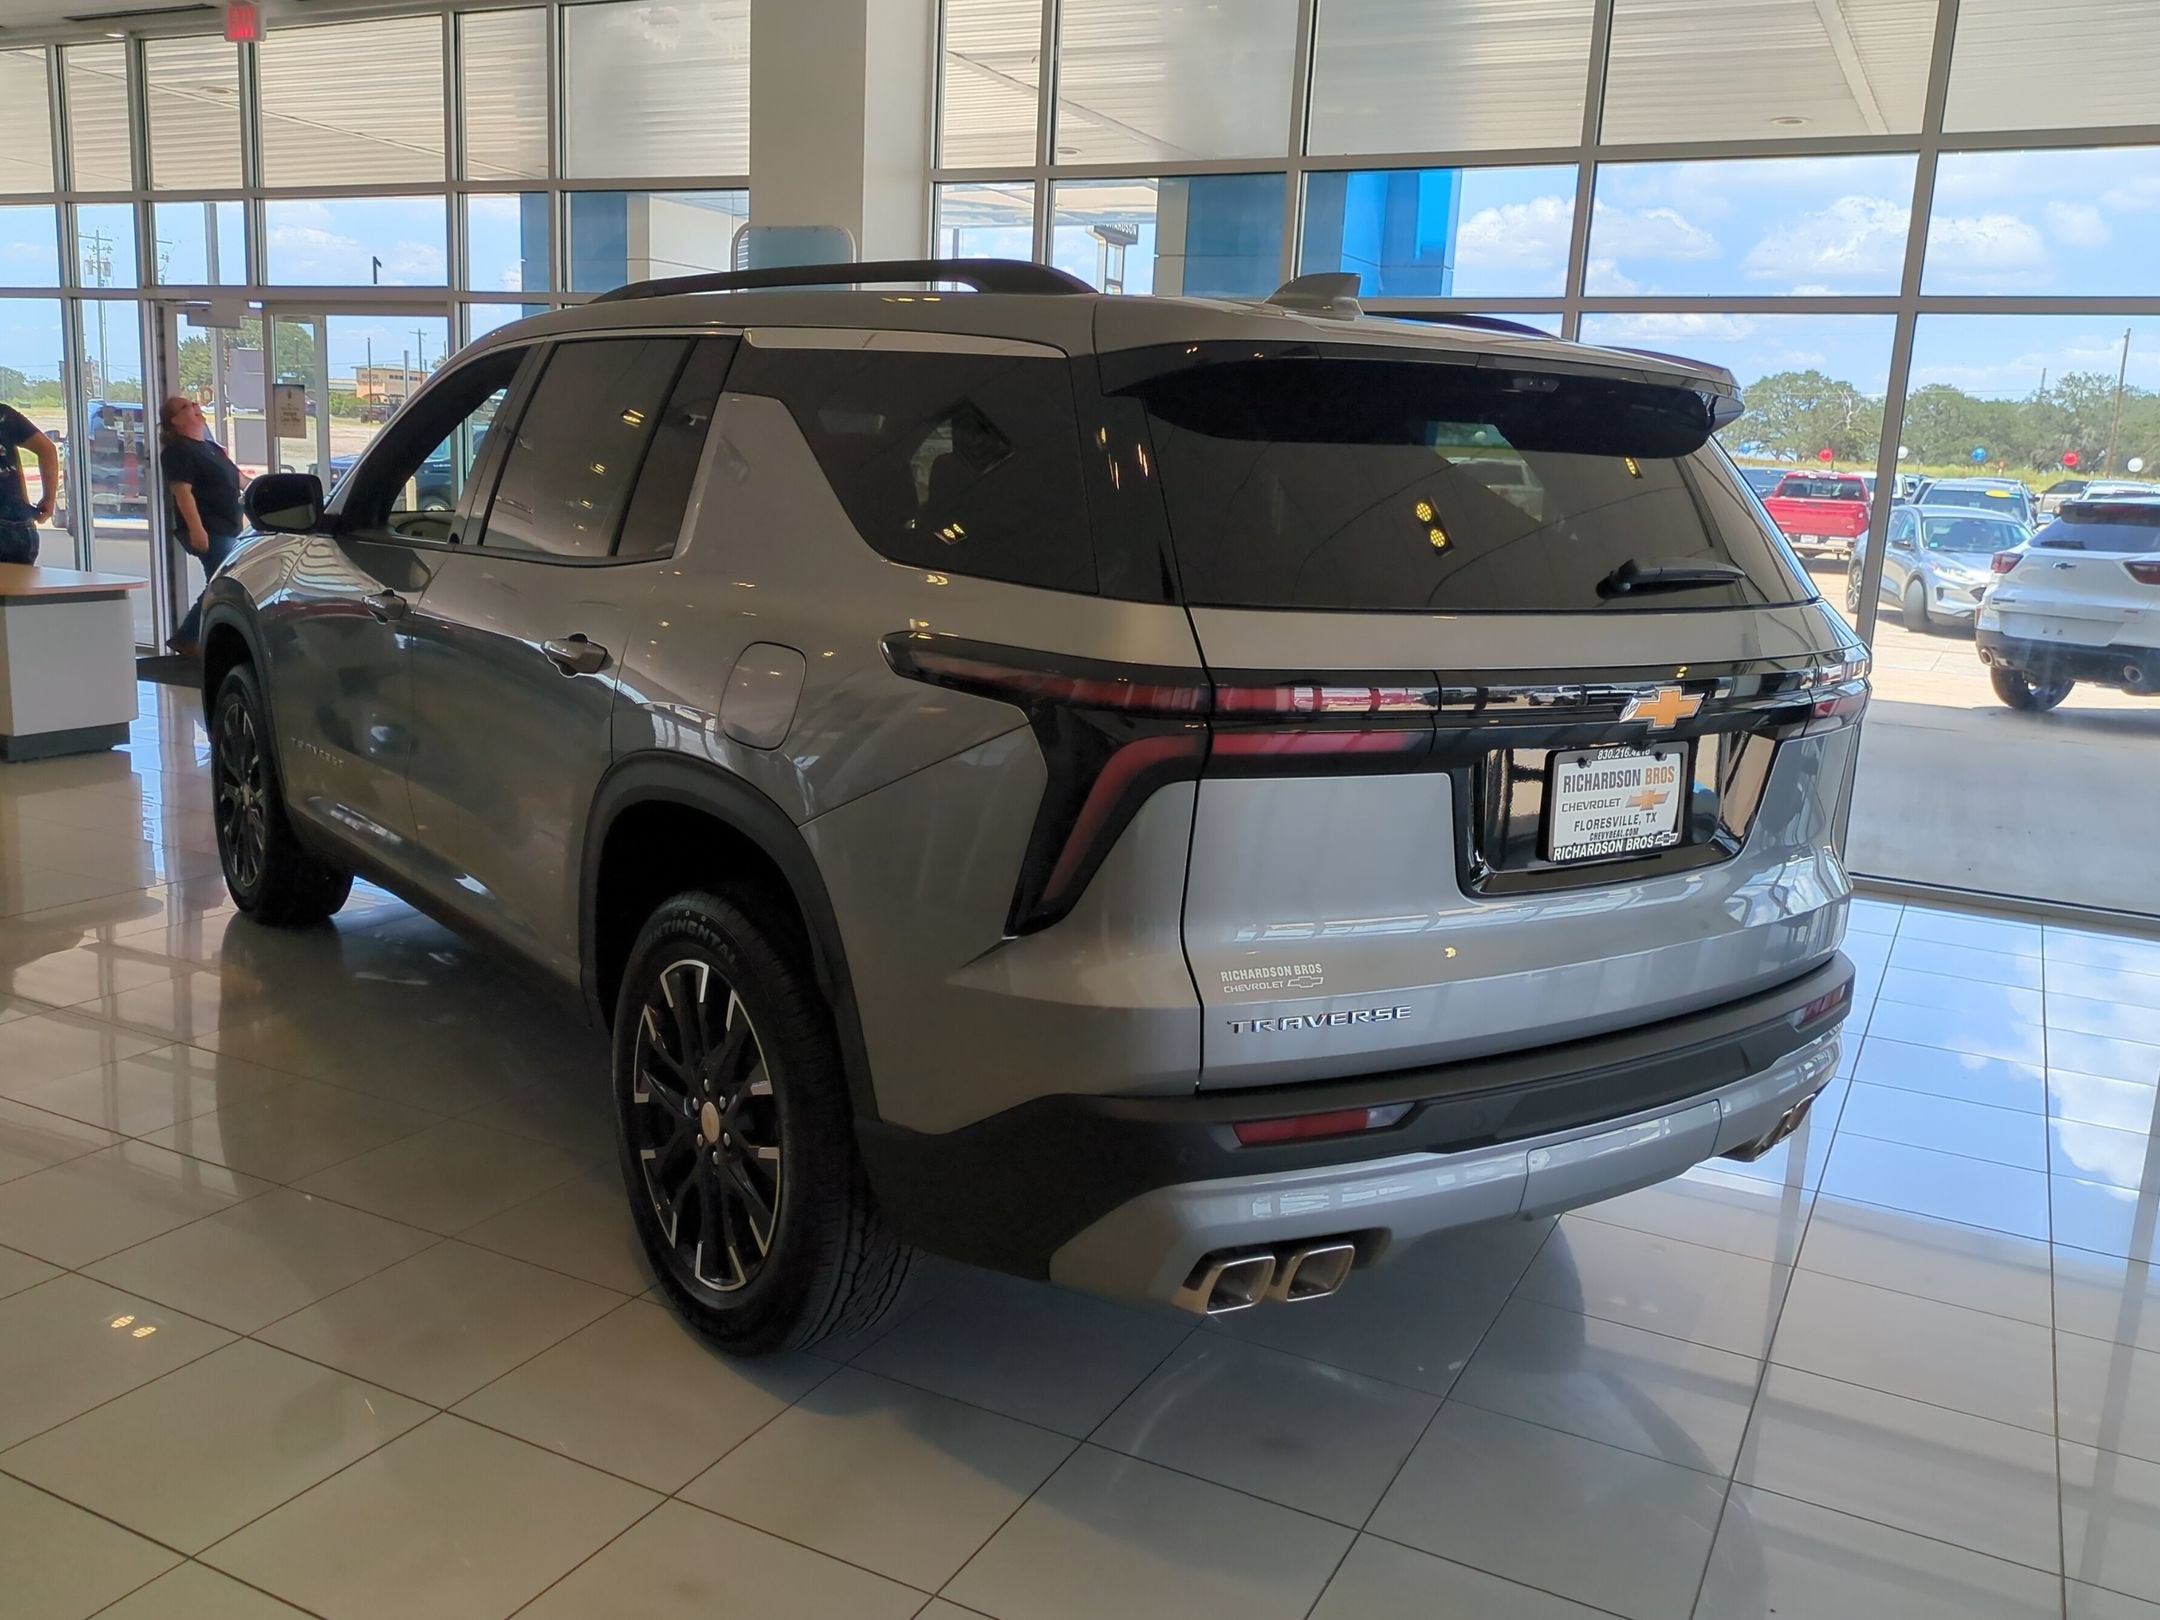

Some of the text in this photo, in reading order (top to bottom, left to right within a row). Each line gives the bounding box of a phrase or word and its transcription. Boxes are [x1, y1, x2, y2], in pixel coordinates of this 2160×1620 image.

[1563, 765, 1675, 793] RICHARDSON BROS
[1562, 798, 1622, 813] CHEVROLET
[1574, 811, 1657, 832] FLORESVILLE, TX
[1590, 828, 1639, 841] CHEVYDEAL.COM
[1553, 835, 1654, 861] RICHARDSON BROS
[1220, 963, 1323, 983] RICHARDSON BROS
[1223, 980, 1285, 994] CHEVROLET
[1226, 1004, 1412, 1034] TRAVERSE
